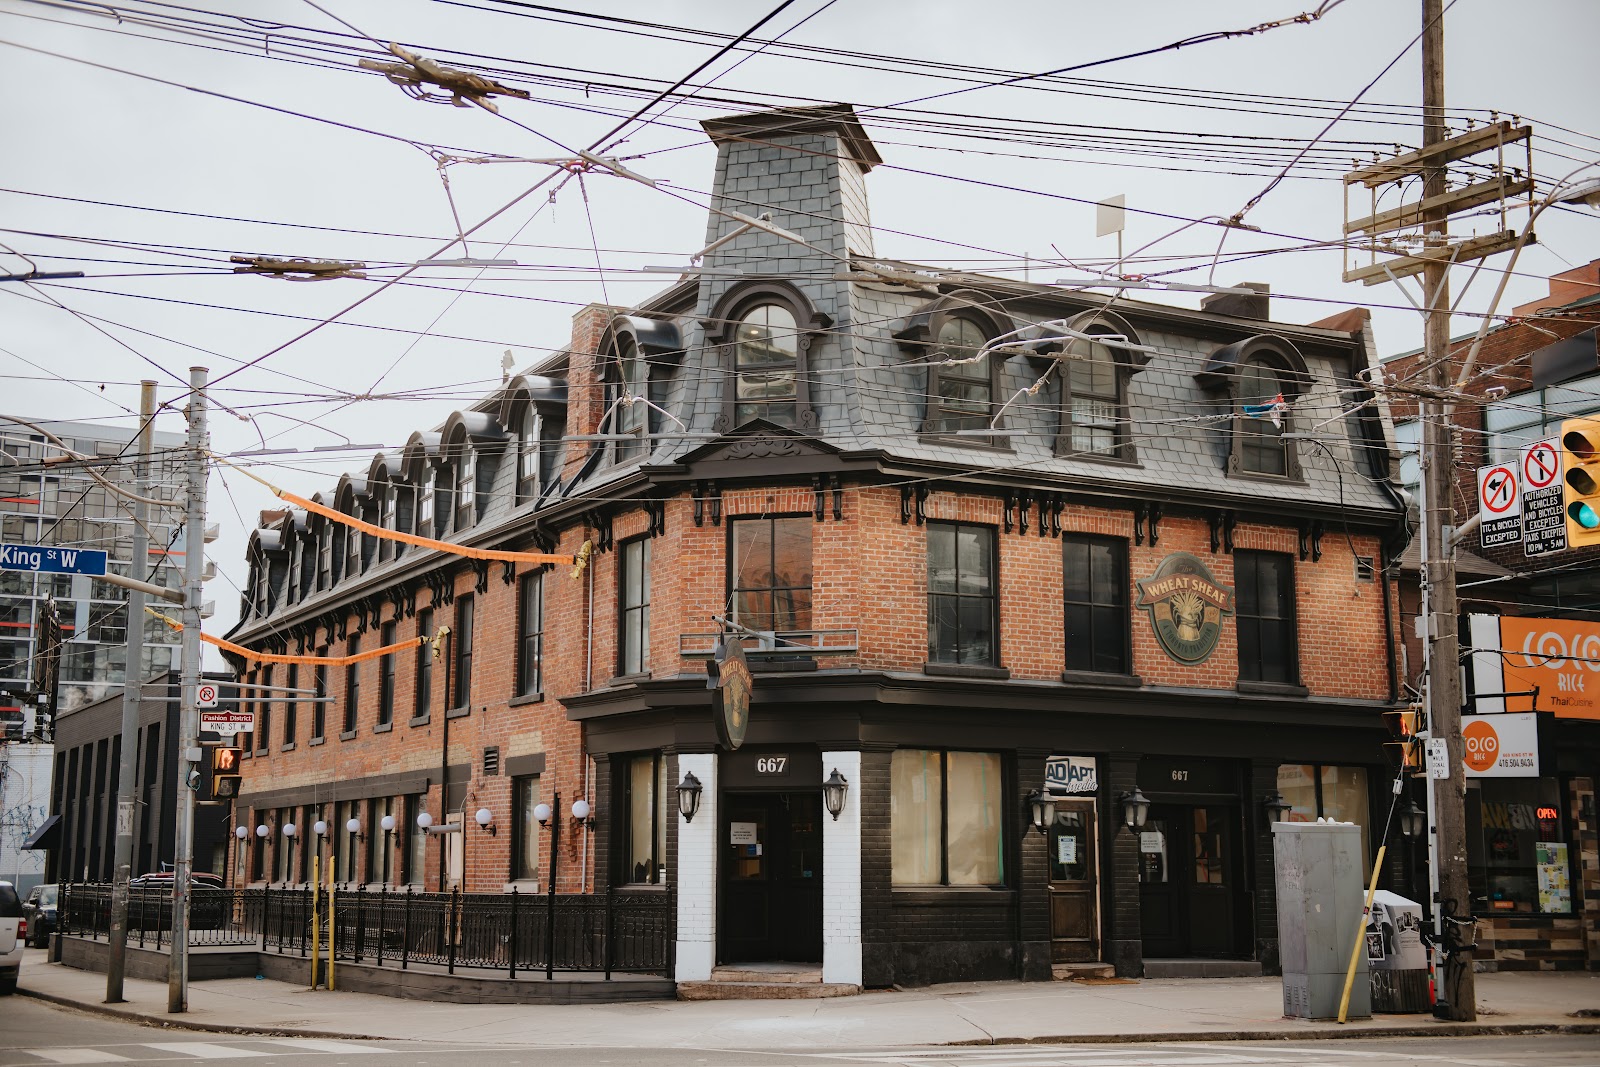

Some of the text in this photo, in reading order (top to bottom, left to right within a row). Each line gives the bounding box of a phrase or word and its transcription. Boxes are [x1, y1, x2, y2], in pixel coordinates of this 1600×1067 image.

[1524, 486, 1562, 502] AUTHORIZED
[1529, 496, 1558, 510] VEHICLES
[1525, 504, 1564, 521] AND BICYCLES
[1482, 524, 1491, 533] TTC
[1497, 518, 1520, 530] BICYCLES
[1529, 516, 1560, 530] EXCEPTED
[1485, 530, 1519, 544] EXCEPTED
[1525, 526, 1565, 542] TAXIS EXCEPTED
[0, 545, 78, 571] King St W
[1147, 577, 1226, 604] WHEAT SHEAF
[1166, 629, 1188, 654] TORONTO
[1189, 627, 1213, 655] TRADITION
[722, 661, 738, 679] WHEAT
[1557, 672, 1585, 693] RICE
[1464, 736, 1497, 752] OCO
[757, 757, 787, 773] 667
[1046, 763, 1095, 782] ADAPT
[1171, 770, 1188, 781] 667
[1536, 808, 1558, 819] OPEN
